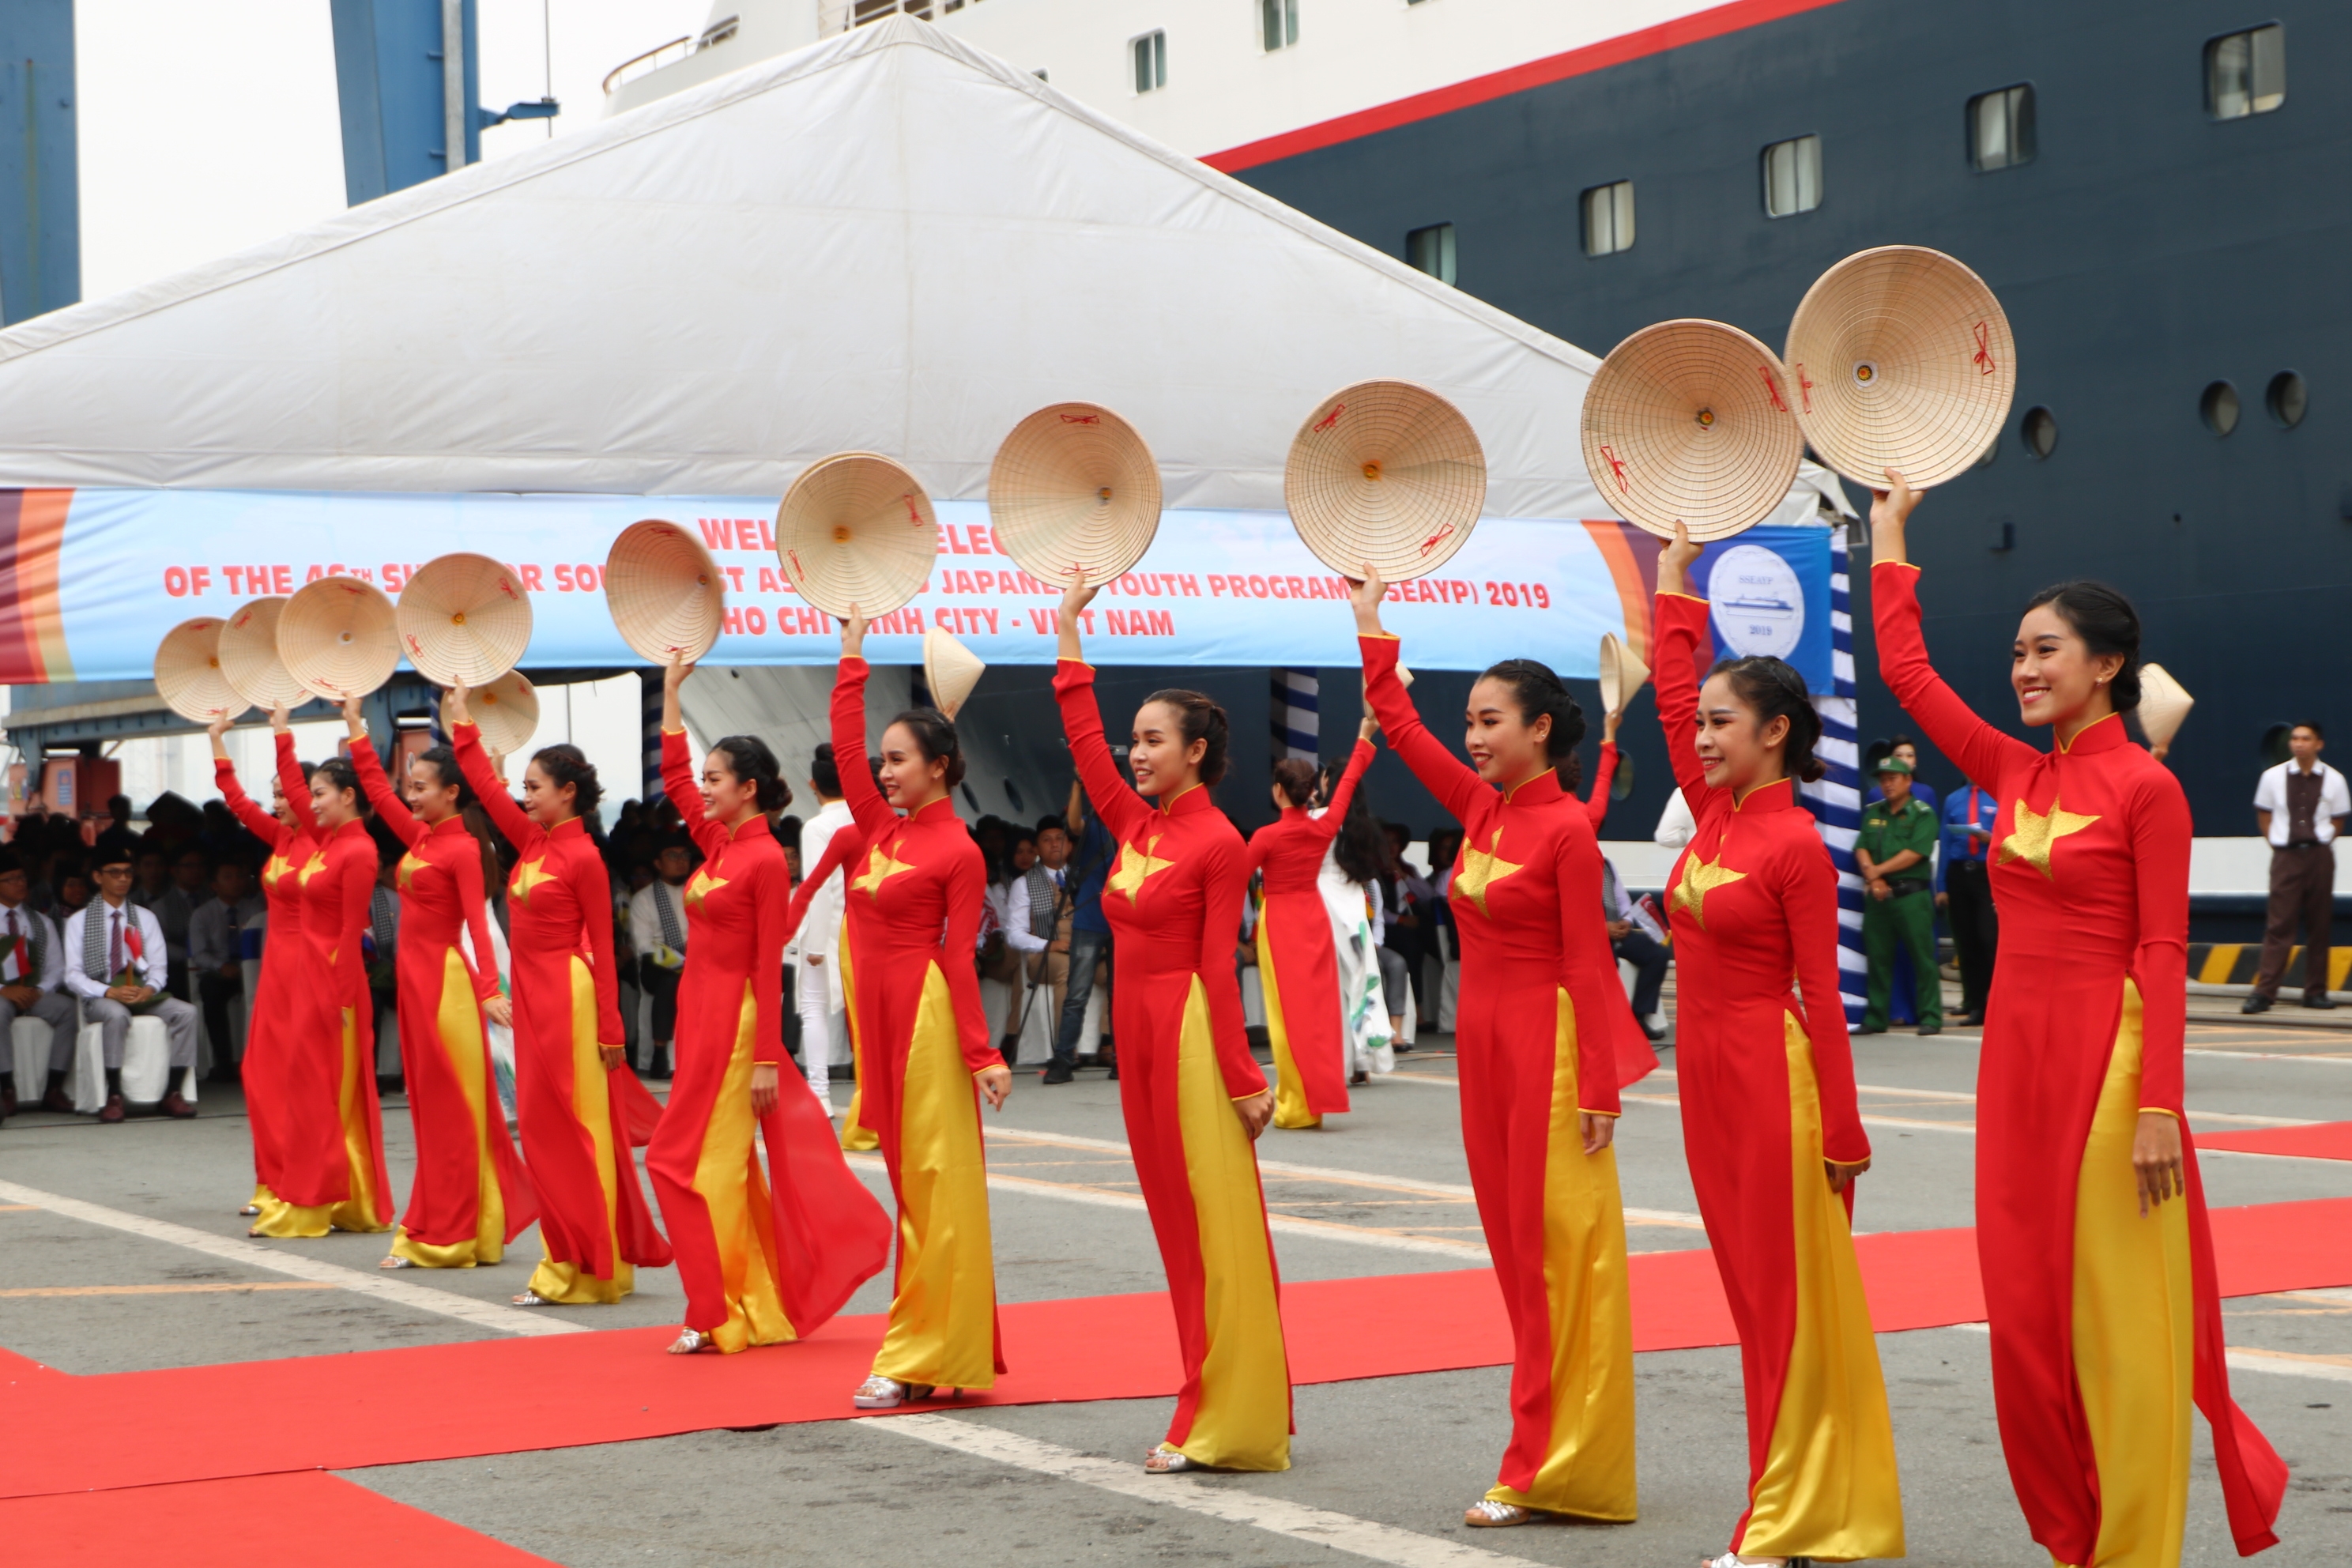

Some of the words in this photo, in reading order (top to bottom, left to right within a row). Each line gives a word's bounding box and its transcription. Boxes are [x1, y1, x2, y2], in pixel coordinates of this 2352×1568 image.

[164, 566, 211, 597] OF
[222, 565, 294, 594] THE
[942, 570, 1067, 594] JAPAN
[1207, 575, 1352, 599] PROGRAM
[1381, 579, 1479, 605] SEAYP)
[1486, 581, 1550, 609] 2019
[722, 606, 767, 635] HO
[777, 606, 832, 635] CHI
[865, 608, 925, 635] INH
[935, 607, 999, 635] CITY
[1028, 609, 1095, 635] VIT
[1106, 609, 1175, 635] NAM
[1748, 624, 1773, 635] 2019
